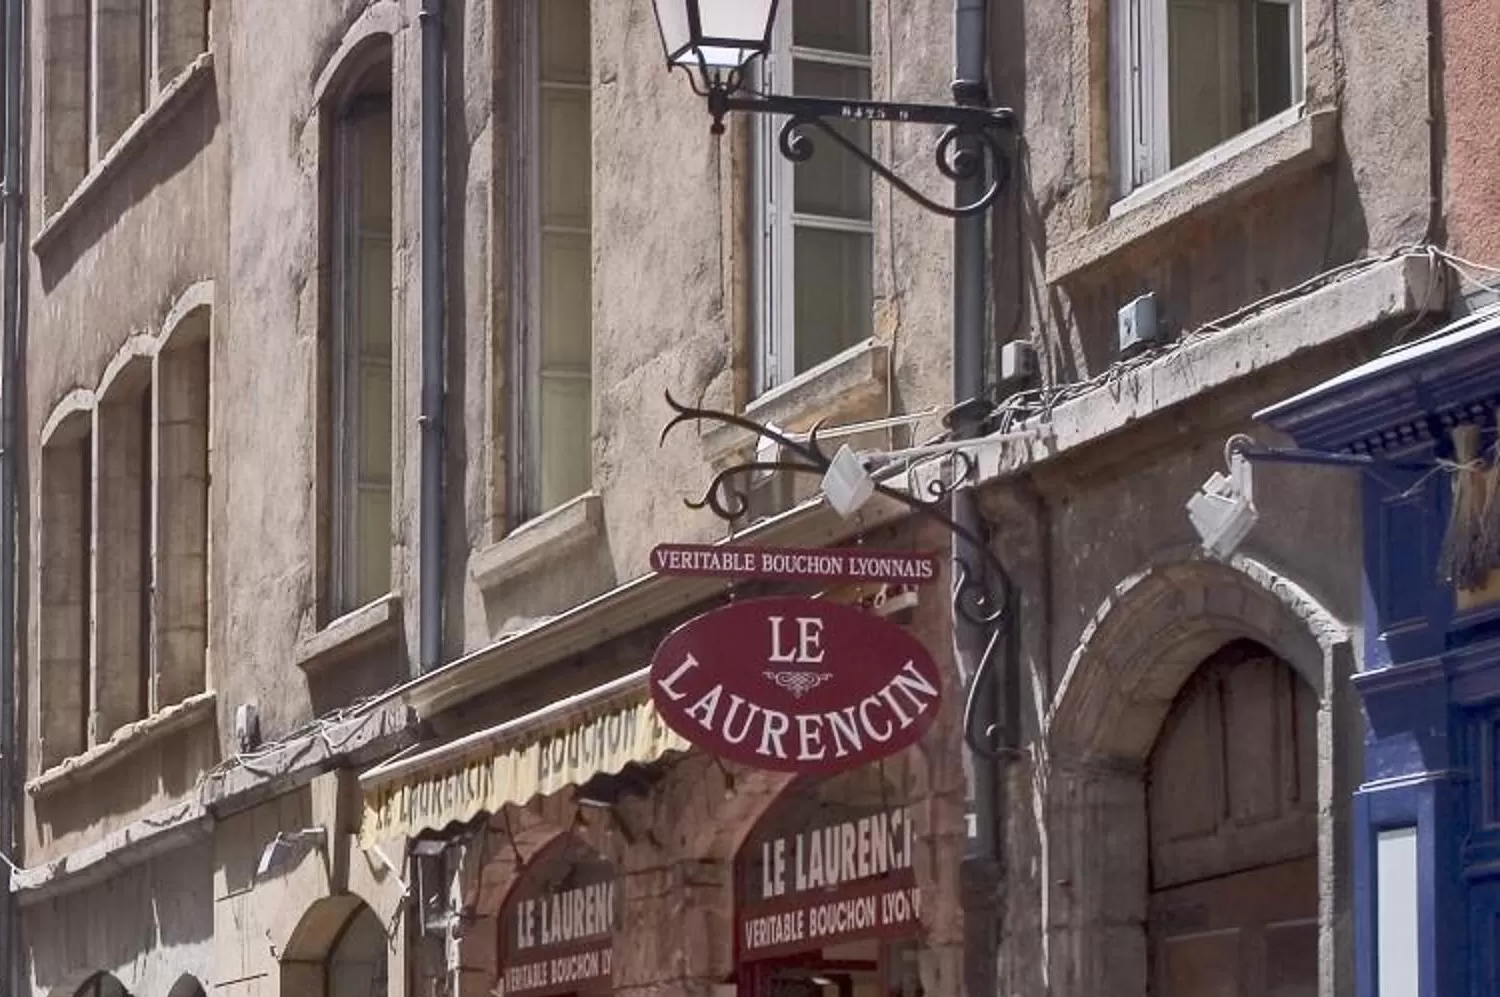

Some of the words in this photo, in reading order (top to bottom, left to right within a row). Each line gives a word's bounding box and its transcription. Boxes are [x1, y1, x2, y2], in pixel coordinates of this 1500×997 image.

[656, 550, 755, 571] VERITABLE
[761, 554, 843, 575] BOUCHON
[849, 556, 933, 577] LYONNAIS
[768, 616, 825, 663] LE
[657, 652, 938, 761] LAURENCIN
[763, 838, 785, 899] LE
[518, 898, 535, 949] LE
[746, 909, 804, 949] VERITABLE
[809, 896, 876, 927] BOUCHON
[551, 951, 599, 984] BOUCHON
